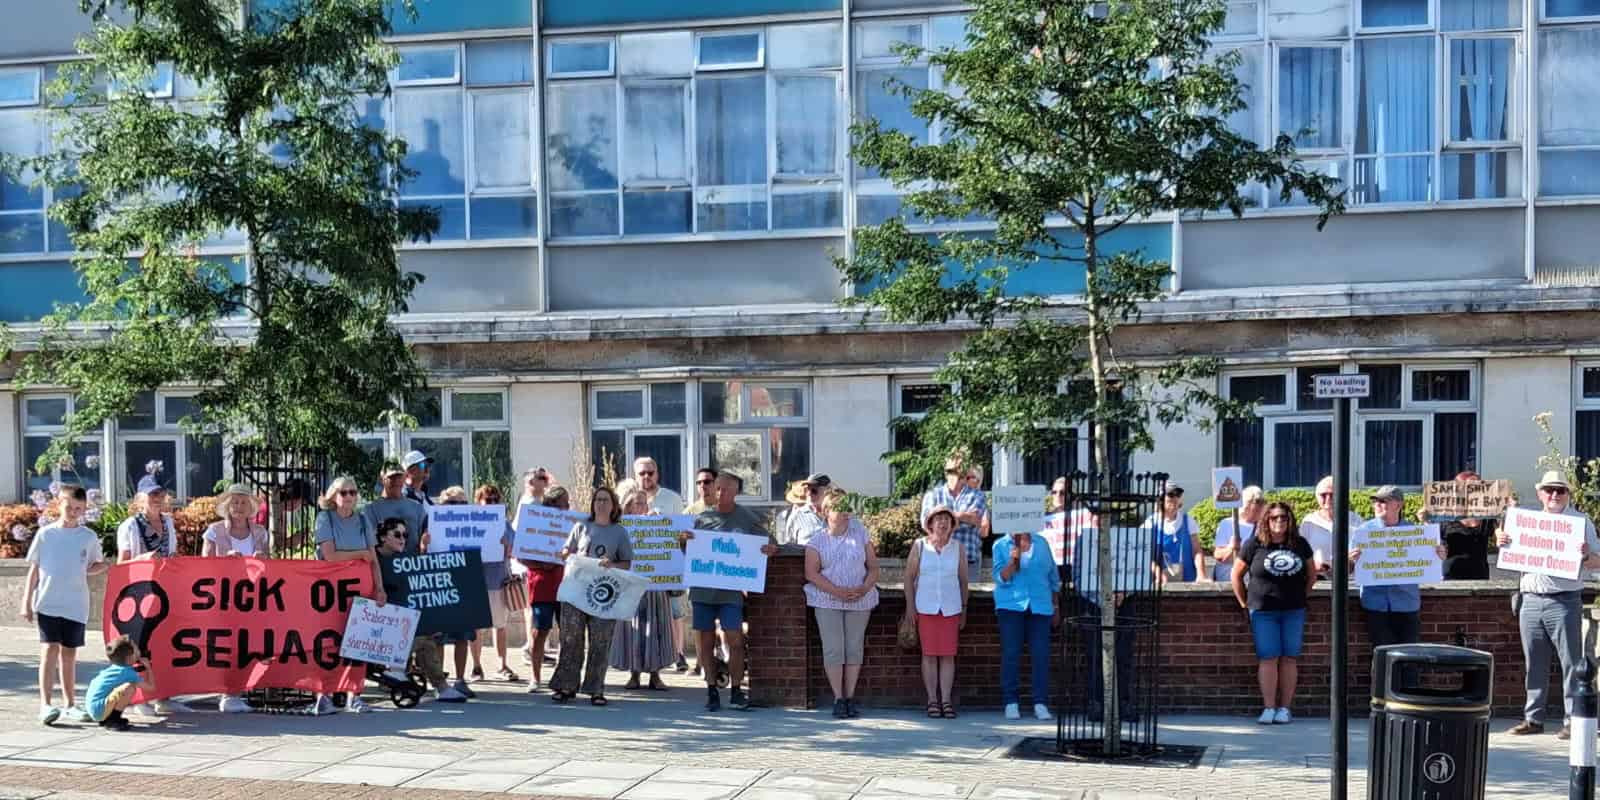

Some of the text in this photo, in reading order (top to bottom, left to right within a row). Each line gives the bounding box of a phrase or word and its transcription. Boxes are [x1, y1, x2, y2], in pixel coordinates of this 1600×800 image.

[1335, 378, 1366, 386] loading
[1348, 386, 1366, 394] time
[1516, 514, 1572, 534] Vote on this
[1519, 532, 1565, 552] Motion to
[392, 552, 466, 574] SOUTHERN
[1527, 554, 1545, 567] our
[1546, 555, 1577, 571] Ocean
[407, 572, 454, 591] WATER
[192, 577, 286, 612] SICK
[310, 577, 360, 613] OF
[407, 588, 460, 609] STINKS
[171, 628, 364, 671] SEWAG
